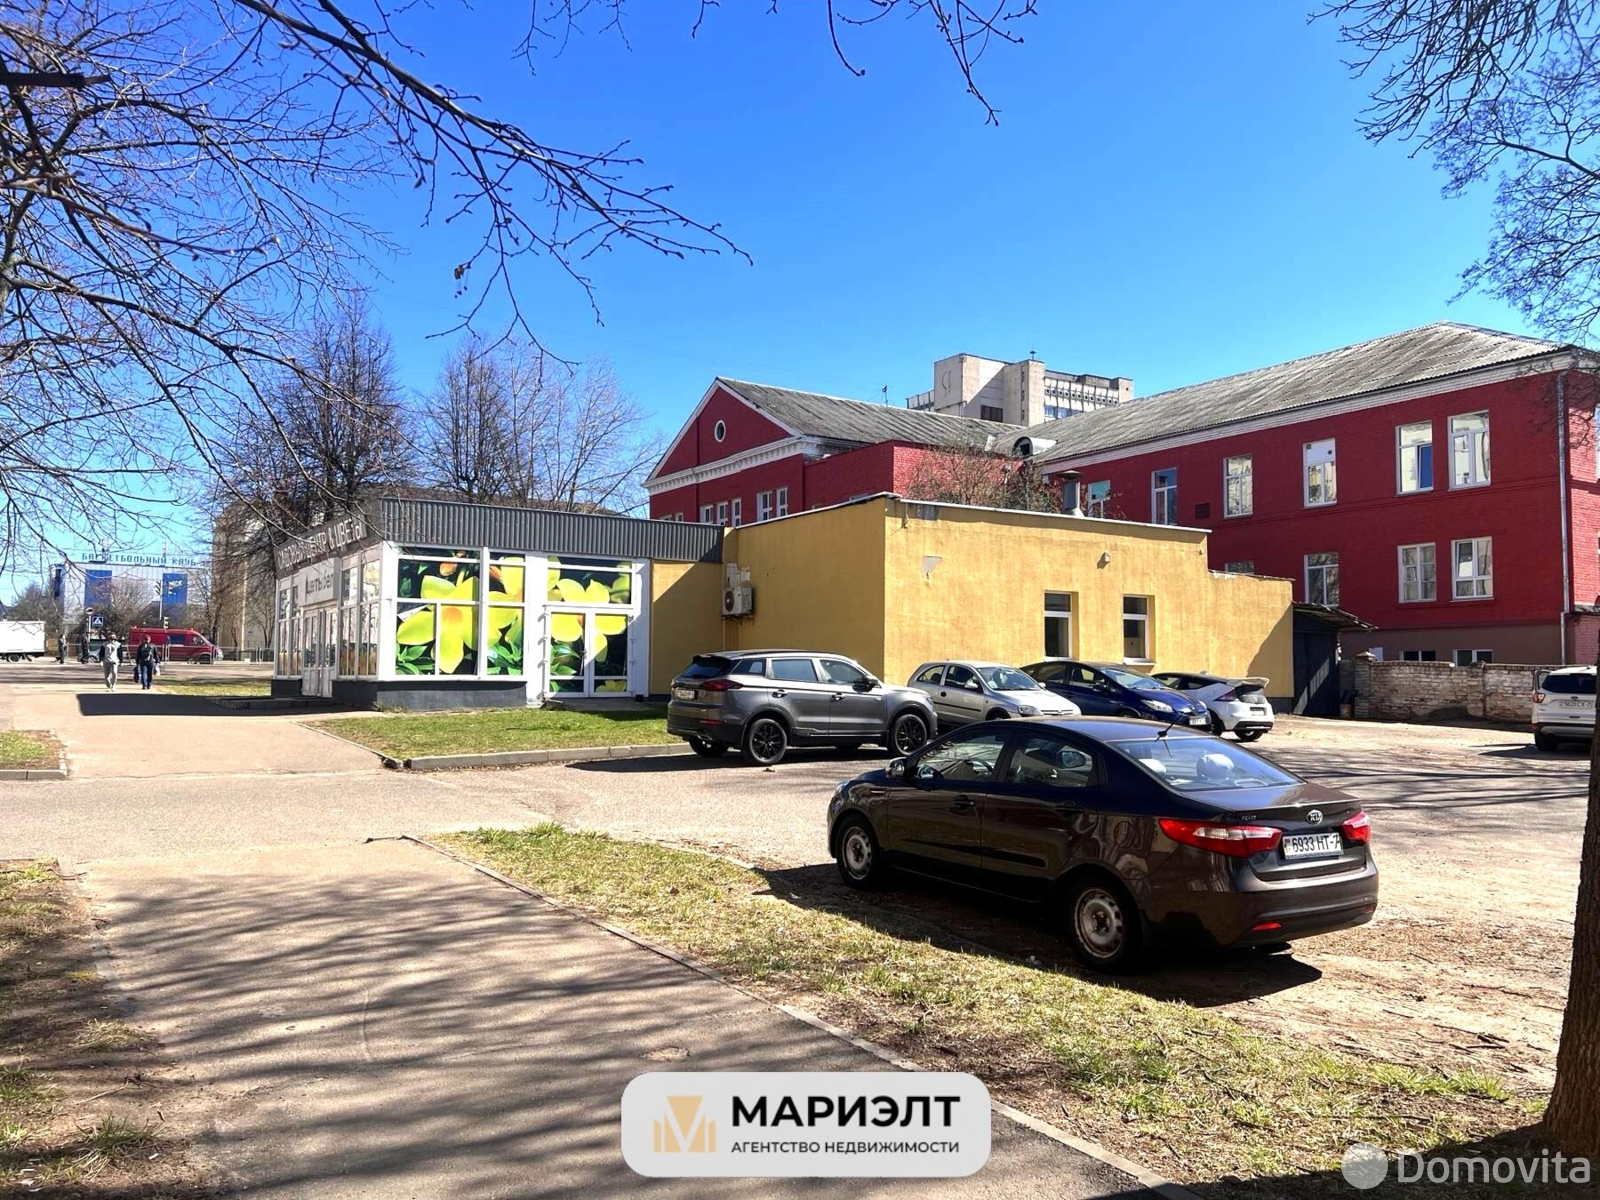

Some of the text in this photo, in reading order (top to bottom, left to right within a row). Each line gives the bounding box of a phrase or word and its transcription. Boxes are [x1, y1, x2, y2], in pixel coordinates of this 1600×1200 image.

[172, 558, 196, 566] КЛУБ
[1292, 834, 1340, 853] 6933 HT-7
